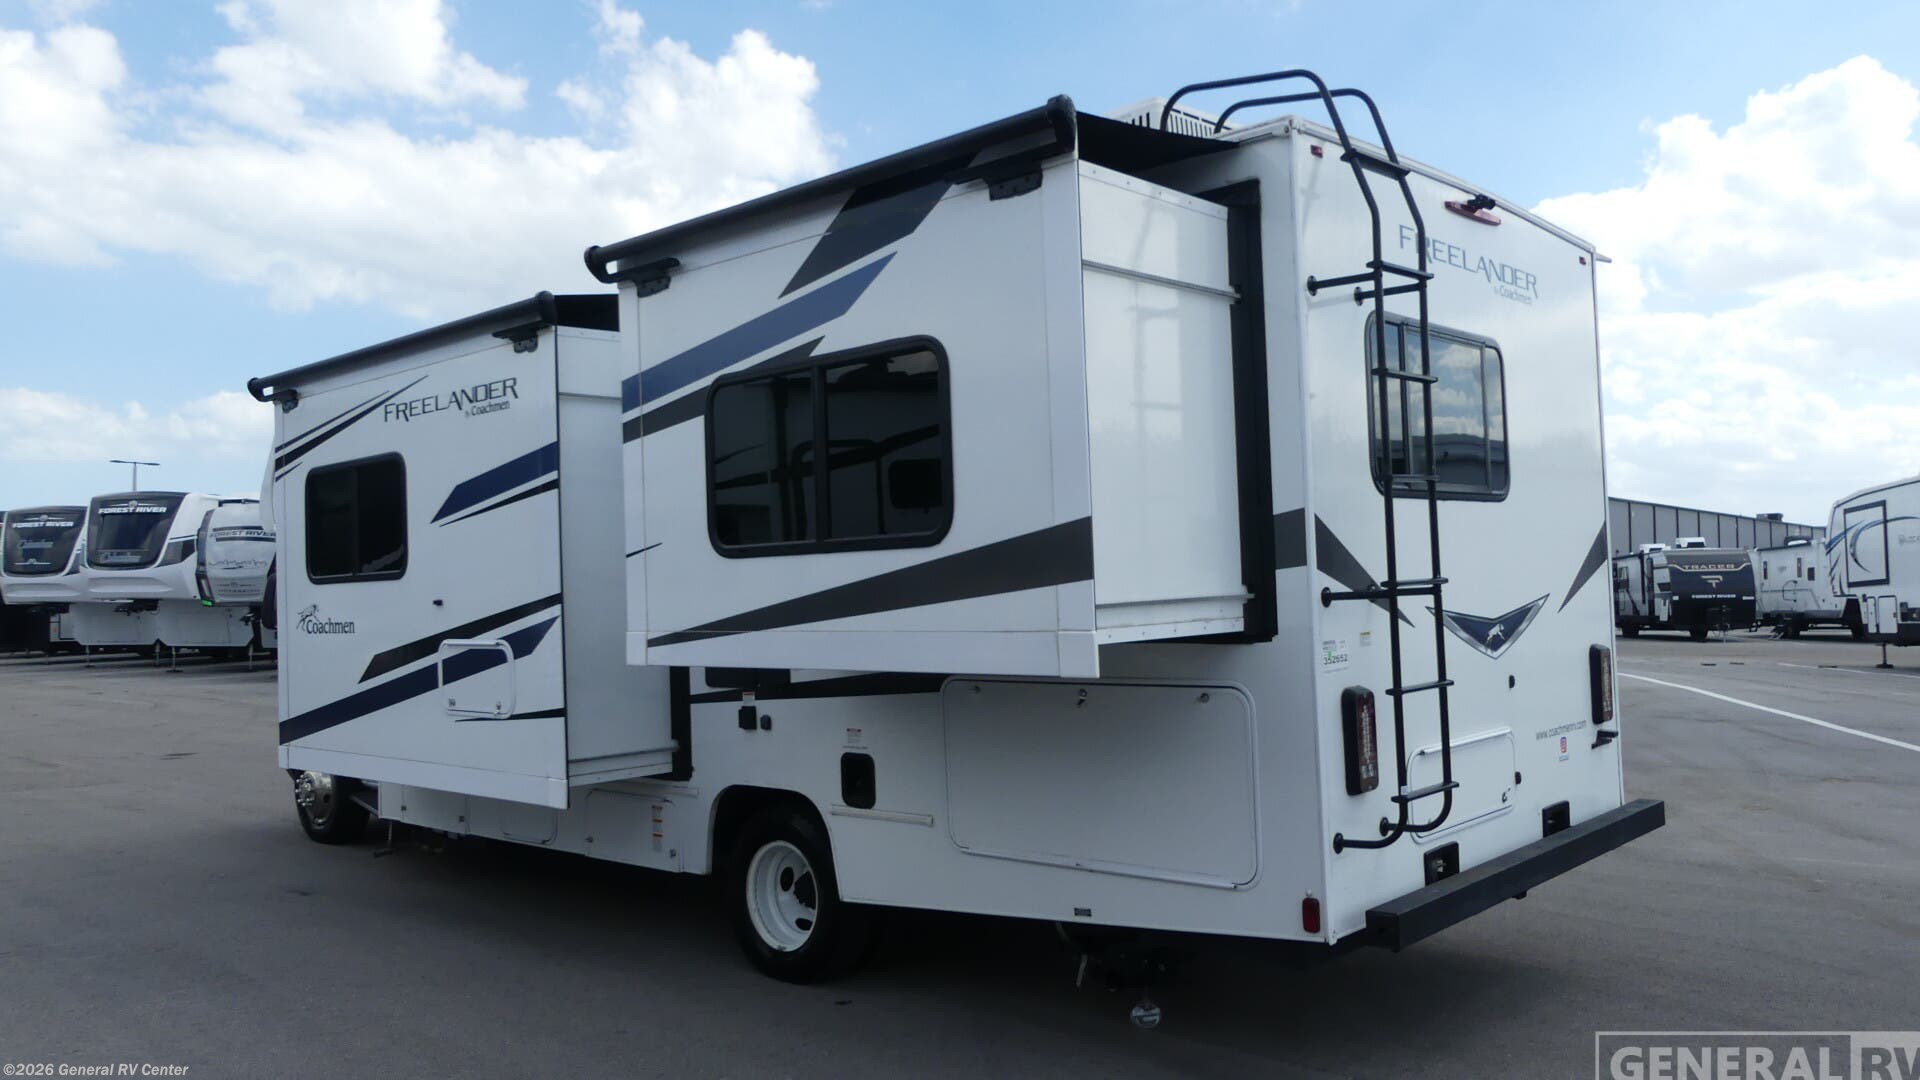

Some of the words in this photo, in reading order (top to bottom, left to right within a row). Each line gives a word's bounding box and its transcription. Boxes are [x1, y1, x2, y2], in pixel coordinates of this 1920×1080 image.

[1399, 224, 1539, 299] FREELANDER
[384, 377, 519, 423] FREELANDER
[471, 400, 511, 416] Coachmen
[306, 617, 355, 635] Coachmen
